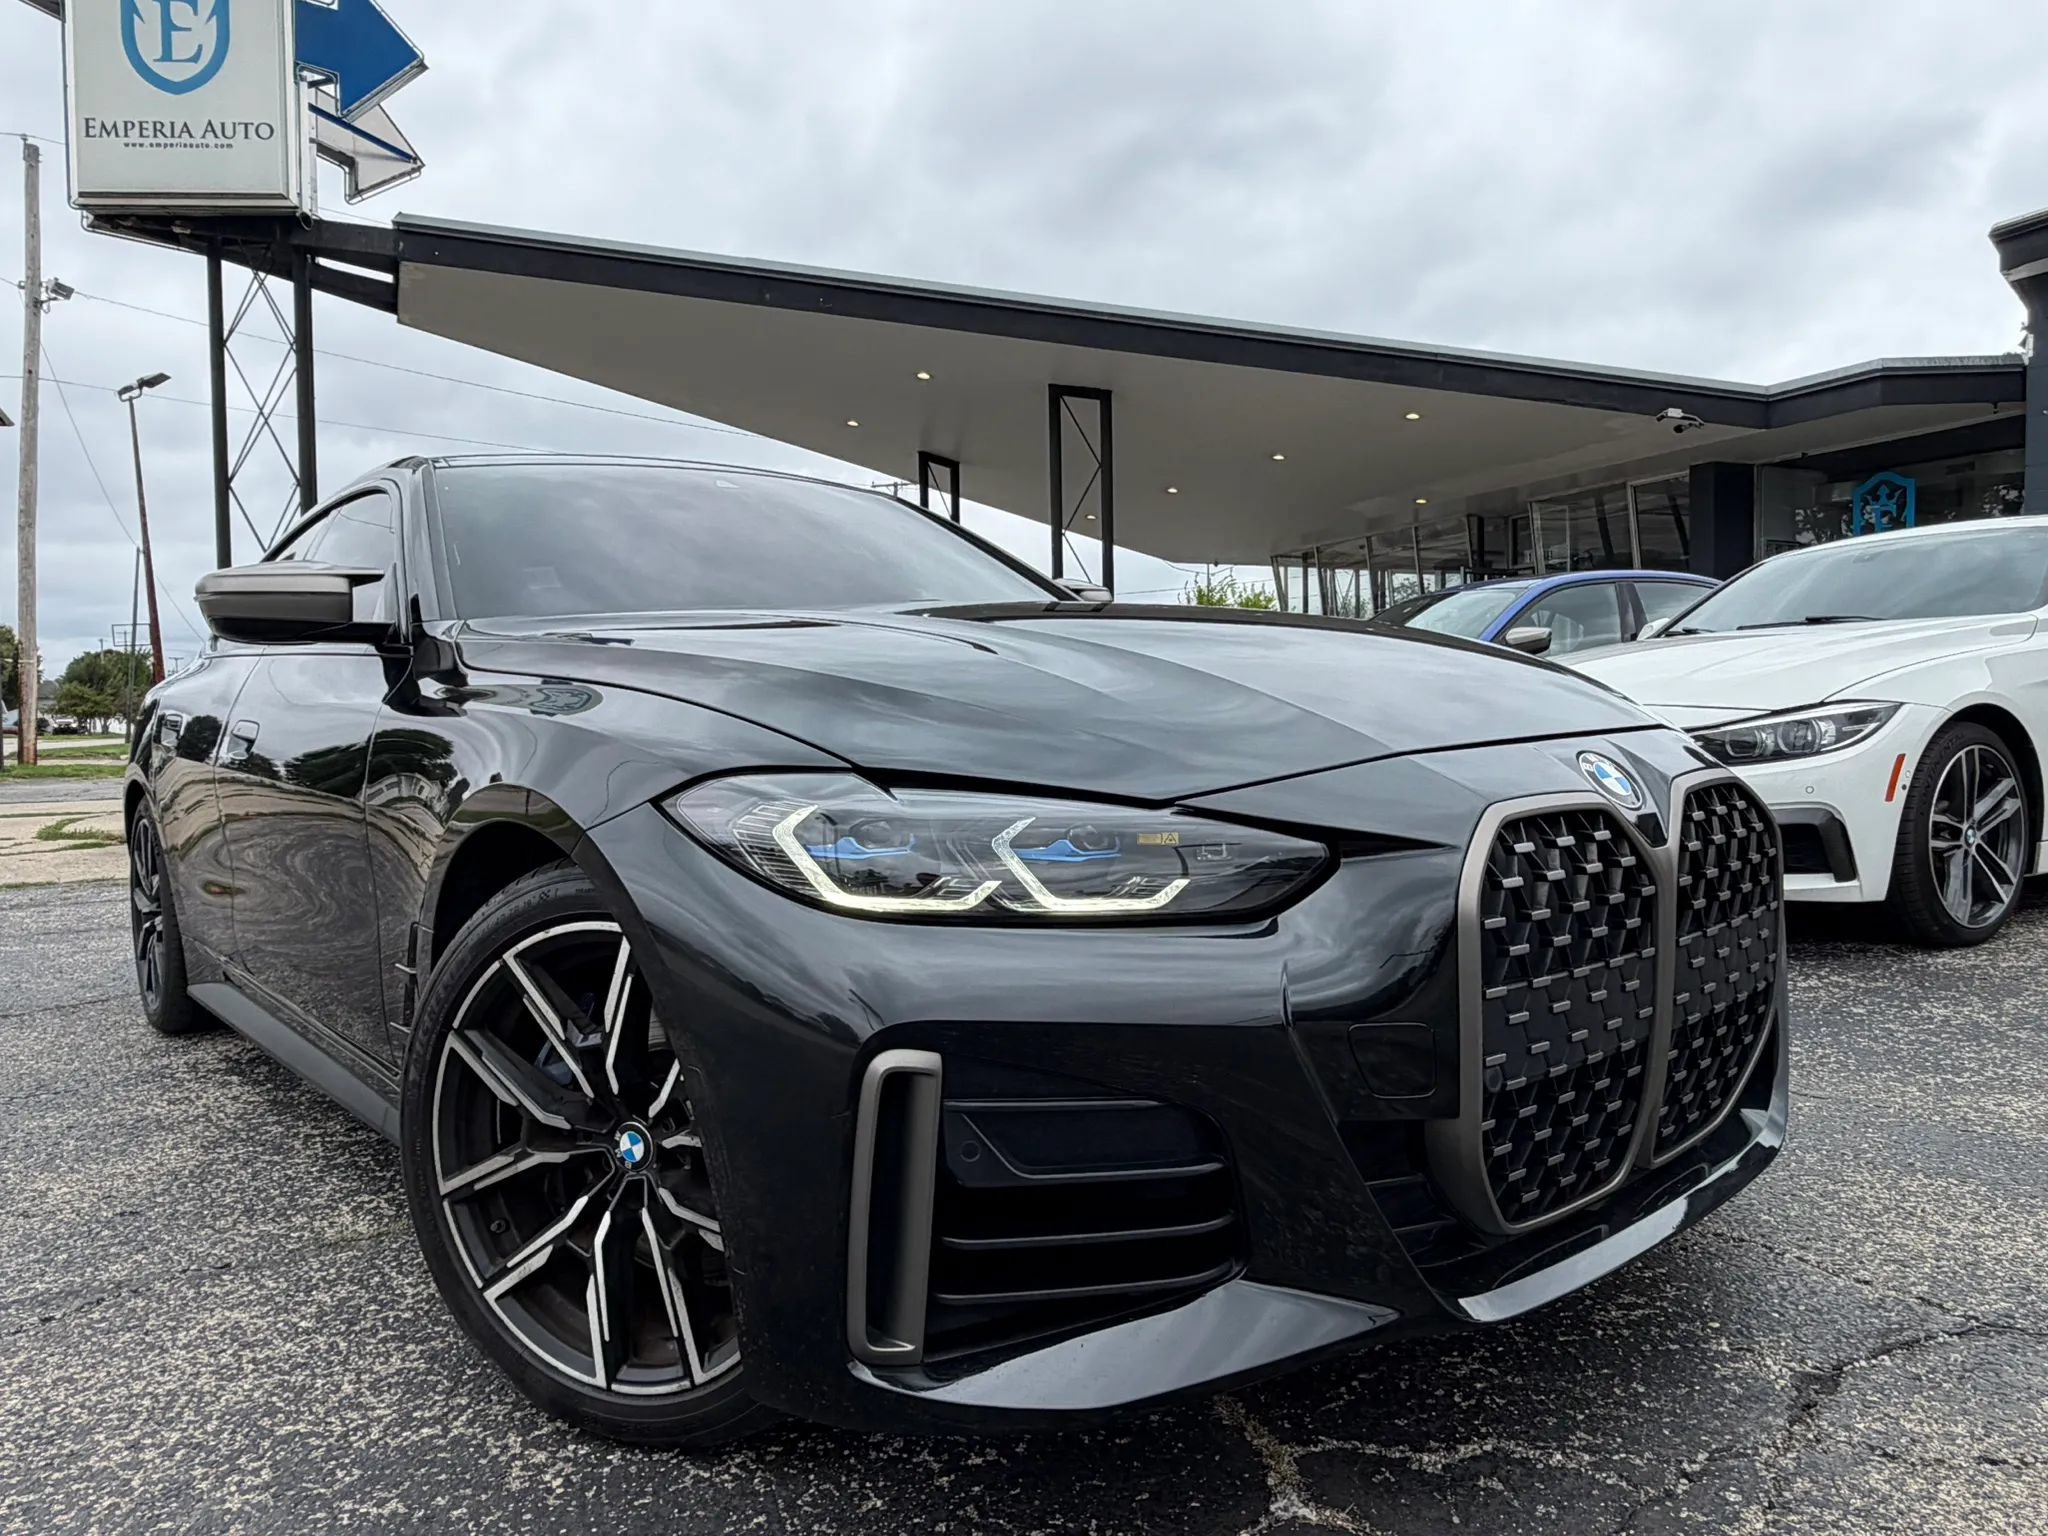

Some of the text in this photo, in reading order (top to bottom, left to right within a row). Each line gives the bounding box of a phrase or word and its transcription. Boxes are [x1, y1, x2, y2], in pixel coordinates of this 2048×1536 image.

[153, 0, 204, 65] E
[83, 117, 275, 141] EMPERIA AUTO
[123, 141, 234, 150] www.emperiaauto.com
